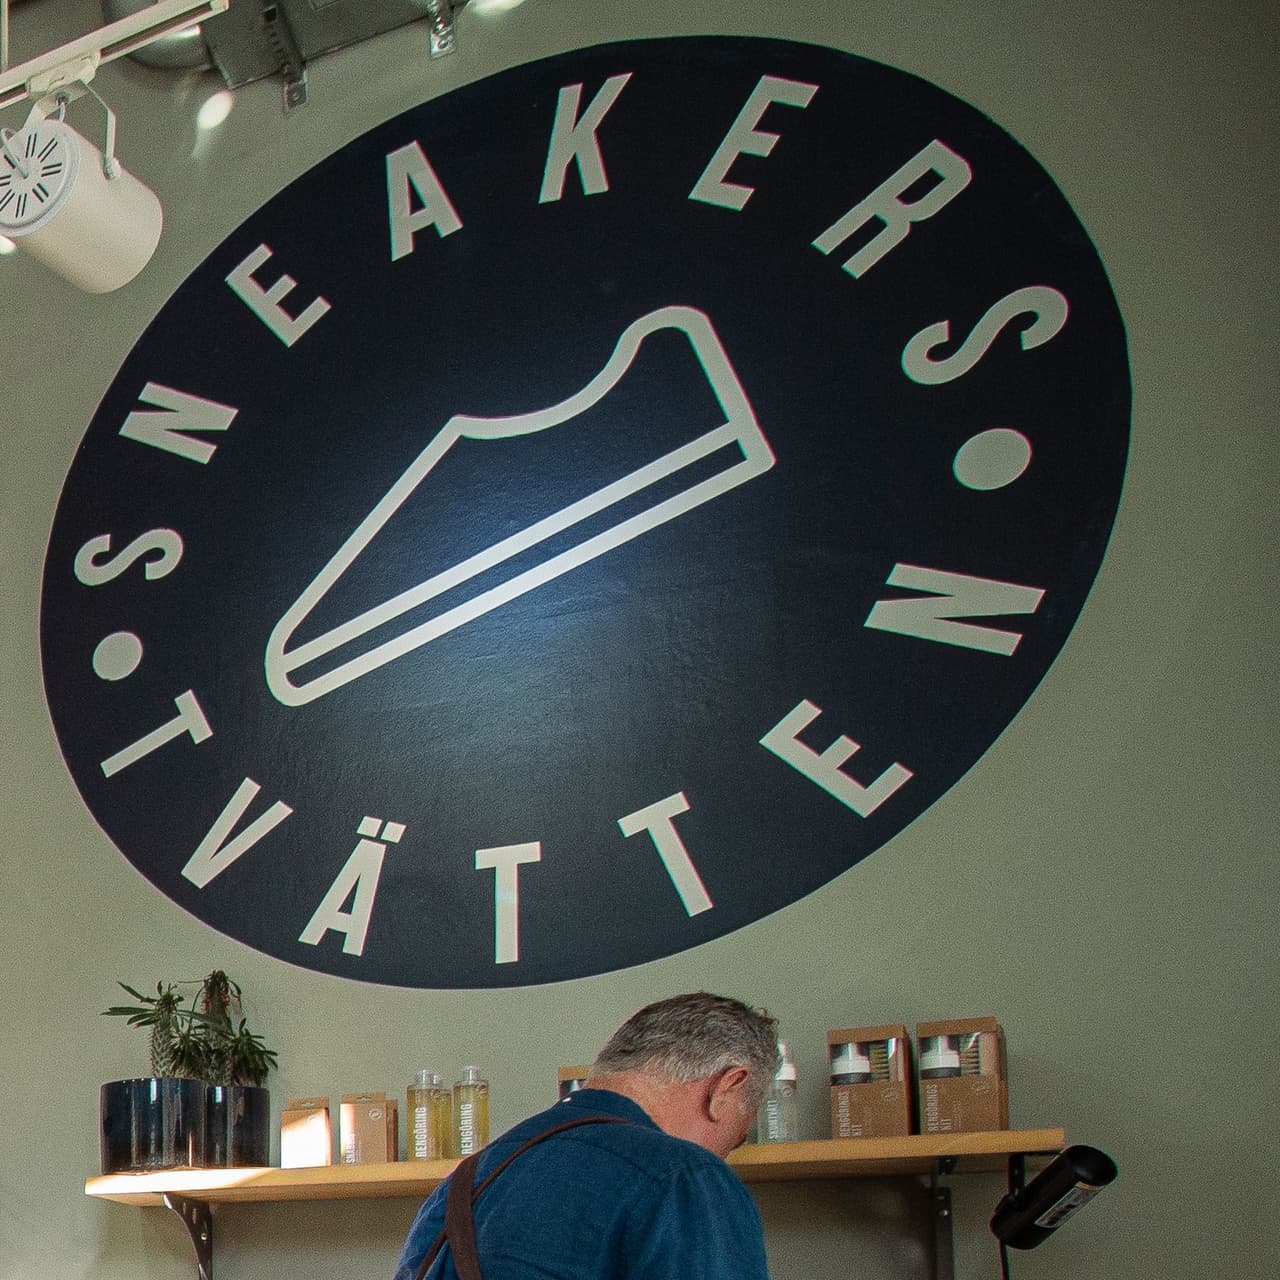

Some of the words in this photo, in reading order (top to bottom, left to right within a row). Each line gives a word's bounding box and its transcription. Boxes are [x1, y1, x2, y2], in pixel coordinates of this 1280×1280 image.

[73, 72, 1069, 586] SNEAKERS
[100, 561, 1046, 964] TVÄTTEN
[413, 1106, 427, 1158] RENGÖRING
[459, 1103, 473, 1155] RENGÖRING
